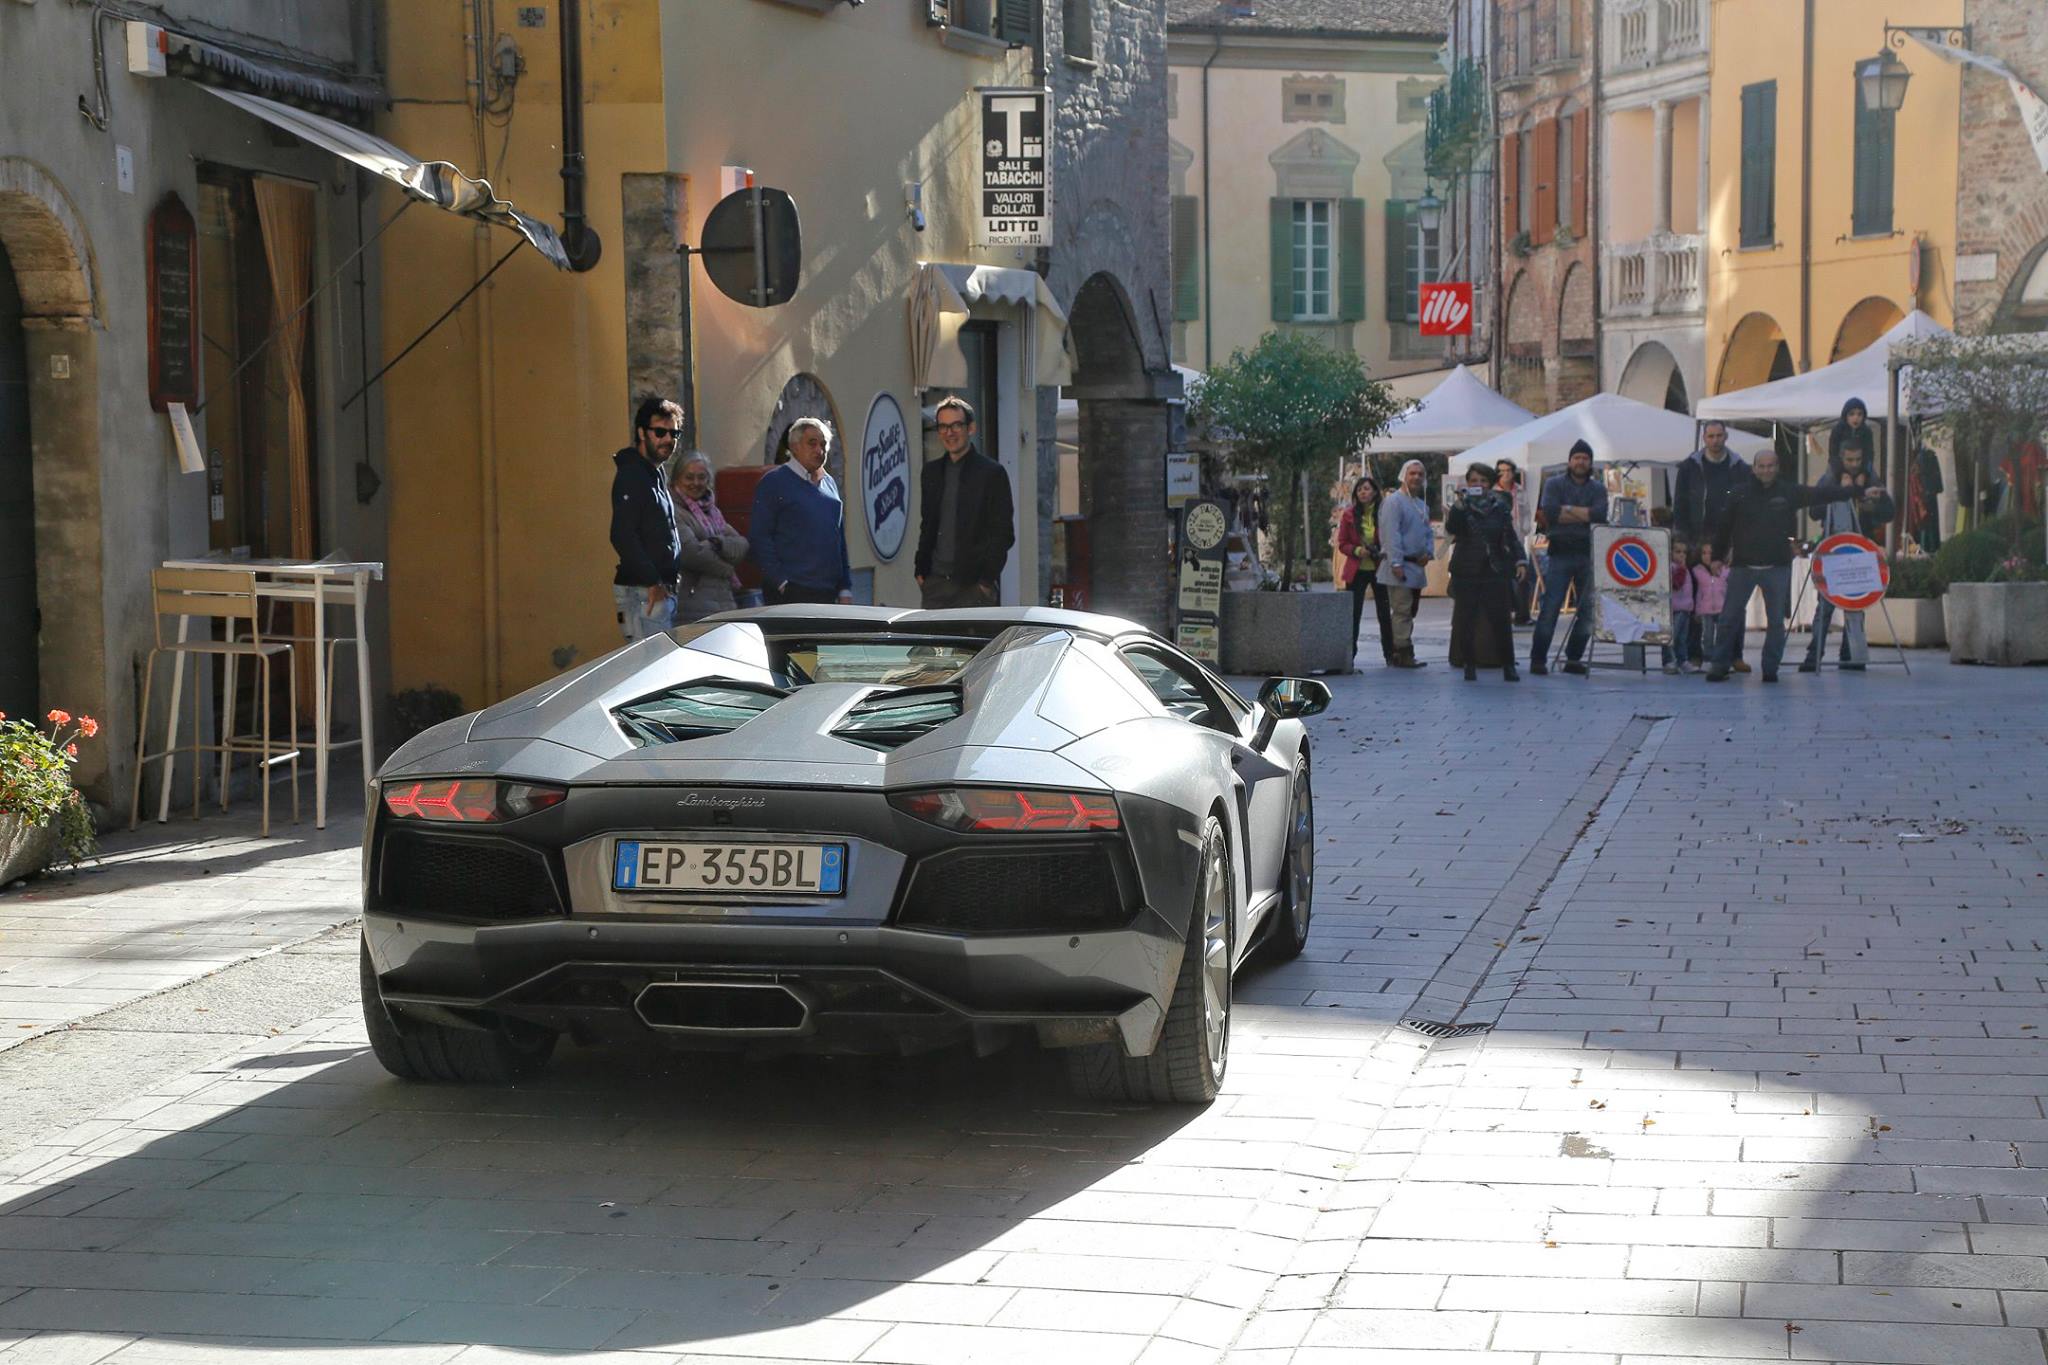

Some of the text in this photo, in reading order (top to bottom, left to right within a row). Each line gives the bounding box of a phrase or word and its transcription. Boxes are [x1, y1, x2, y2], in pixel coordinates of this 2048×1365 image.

[991, 97, 1036, 158] T
[998, 161, 1030, 171] SALI E
[985, 171, 1043, 185] TABACCHI
[995, 193, 1034, 203] VALORI
[991, 204, 1036, 215] BOLLATI
[989, 220, 1039, 232] LOTTO
[1423, 289, 1469, 331] illy
[865, 442, 906, 491] Tabacchi
[676, 793, 767, 810] Lamborghini
[641, 847, 686, 885] EP
[701, 848, 815, 887] 355BL
